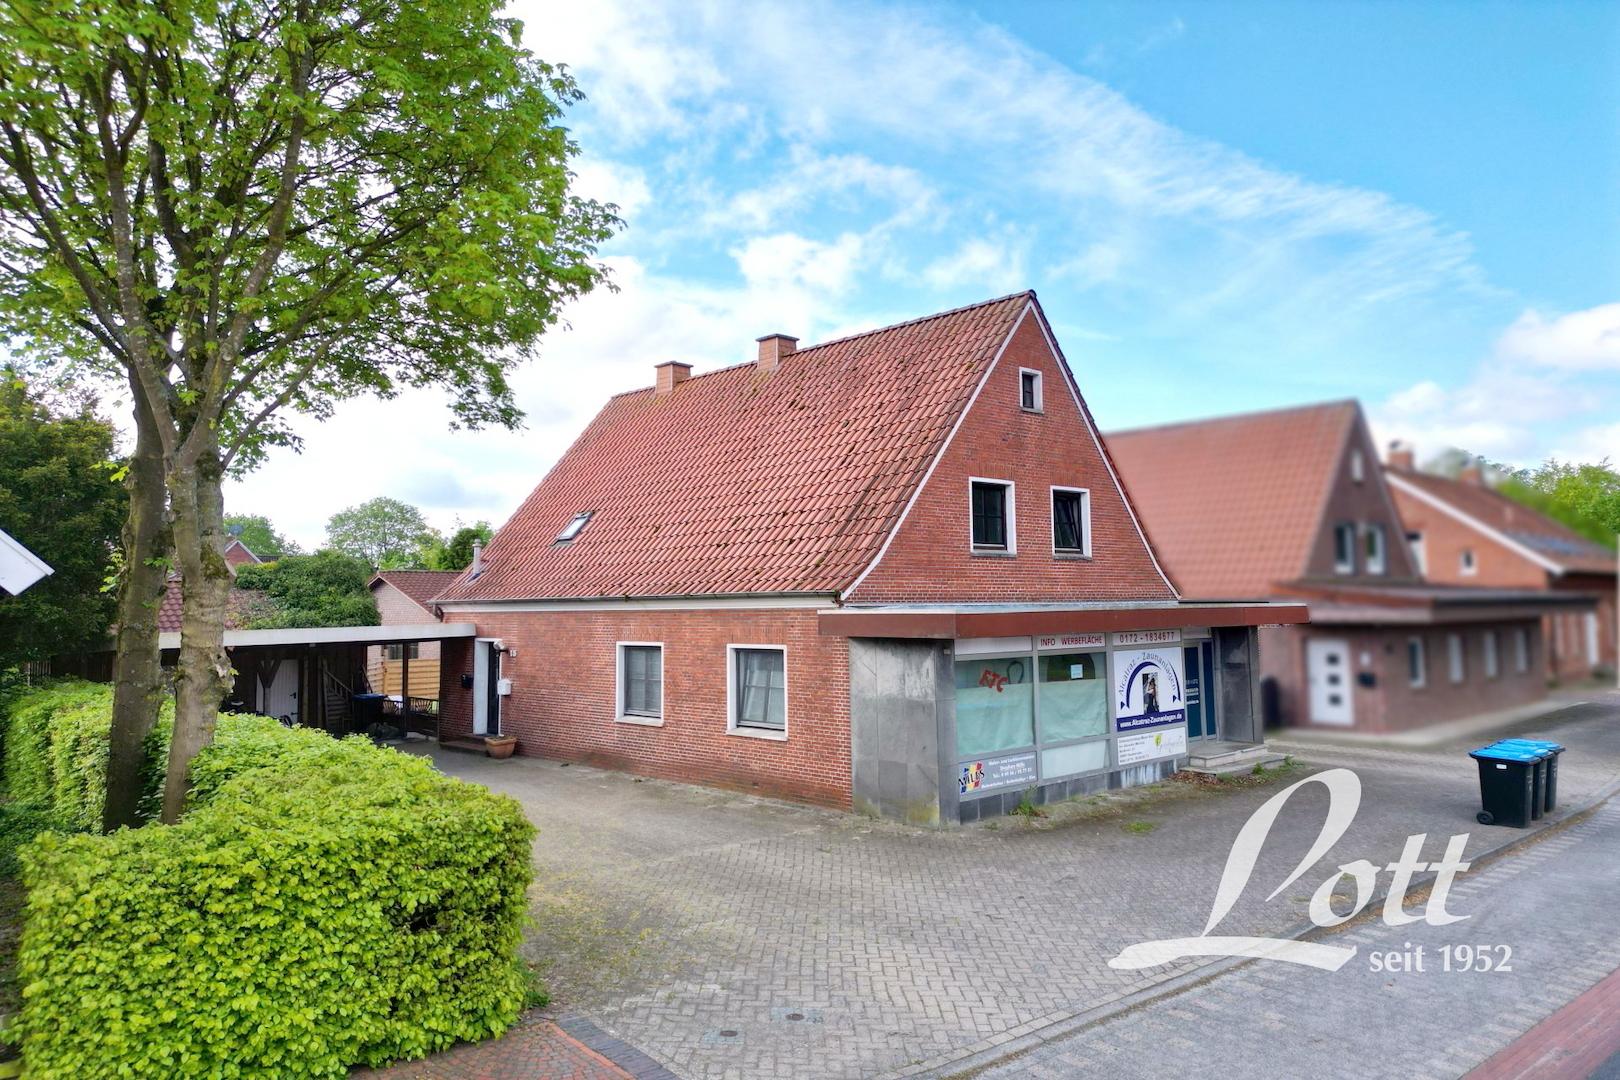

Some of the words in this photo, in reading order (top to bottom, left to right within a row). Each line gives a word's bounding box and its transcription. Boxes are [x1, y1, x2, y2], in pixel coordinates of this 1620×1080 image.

[1040, 637, 1056, 647] INFO
[1061, 634, 1102, 646] WERBEFLÄCHE
[1119, 633, 1138, 643] 0172
